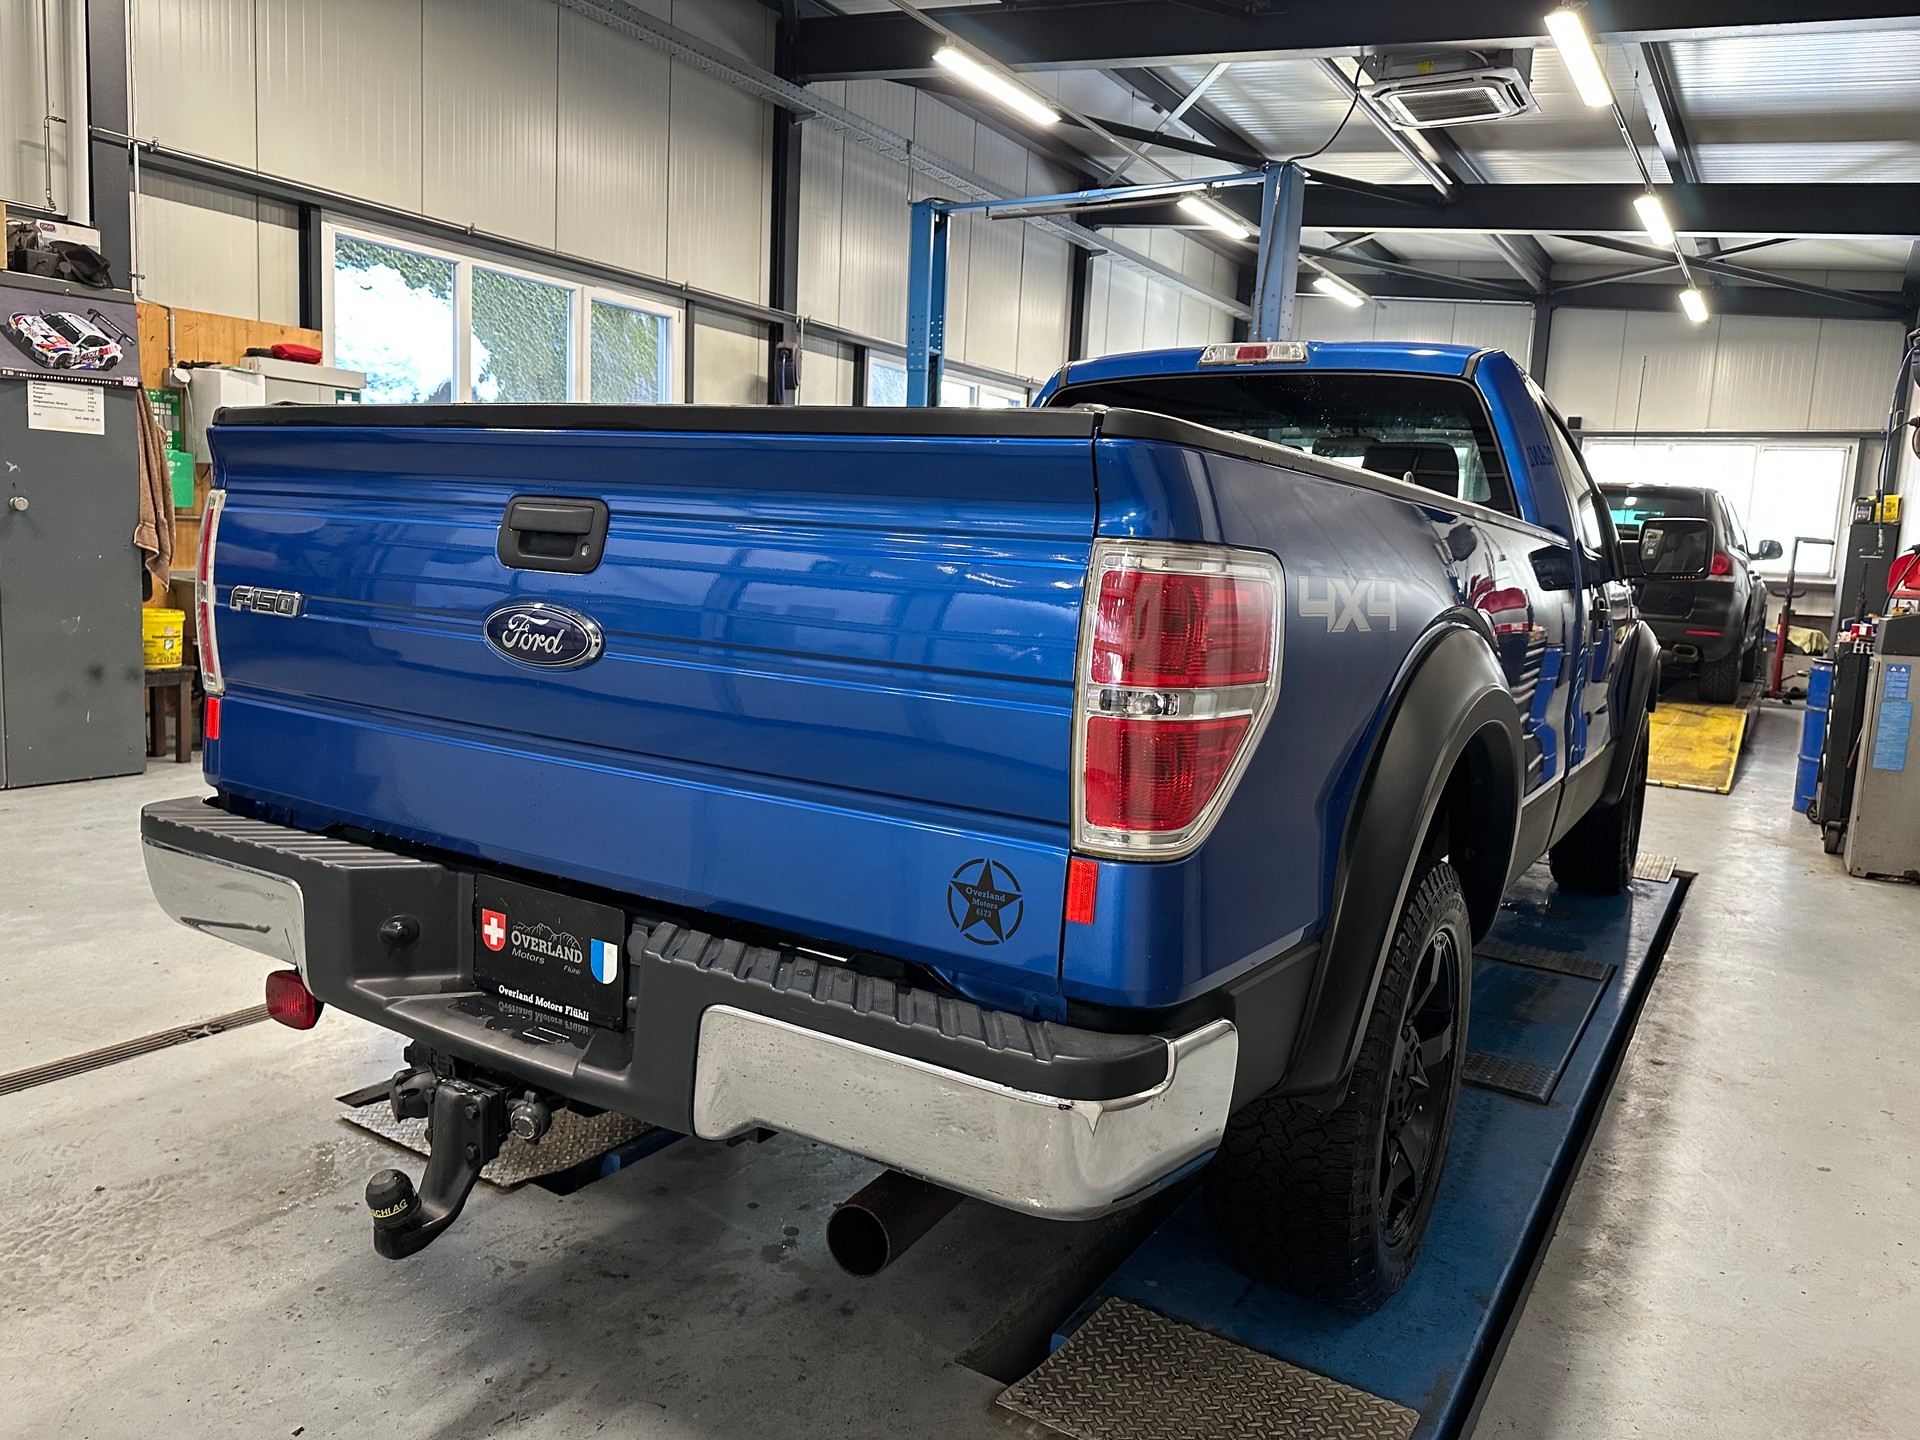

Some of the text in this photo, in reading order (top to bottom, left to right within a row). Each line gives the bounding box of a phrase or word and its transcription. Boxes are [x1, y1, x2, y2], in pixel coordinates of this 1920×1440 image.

[229, 585, 302, 618] F-150
[502, 613, 565, 655] Ford
[965, 886, 1006, 902] Overland
[971, 897, 998, 910] Motors
[975, 907, 992, 918] 6173
[511, 930, 583, 964] OVERLAND
[511, 947, 545, 965] Motors
[498, 984, 590, 1022] Overland Motors Flühli
